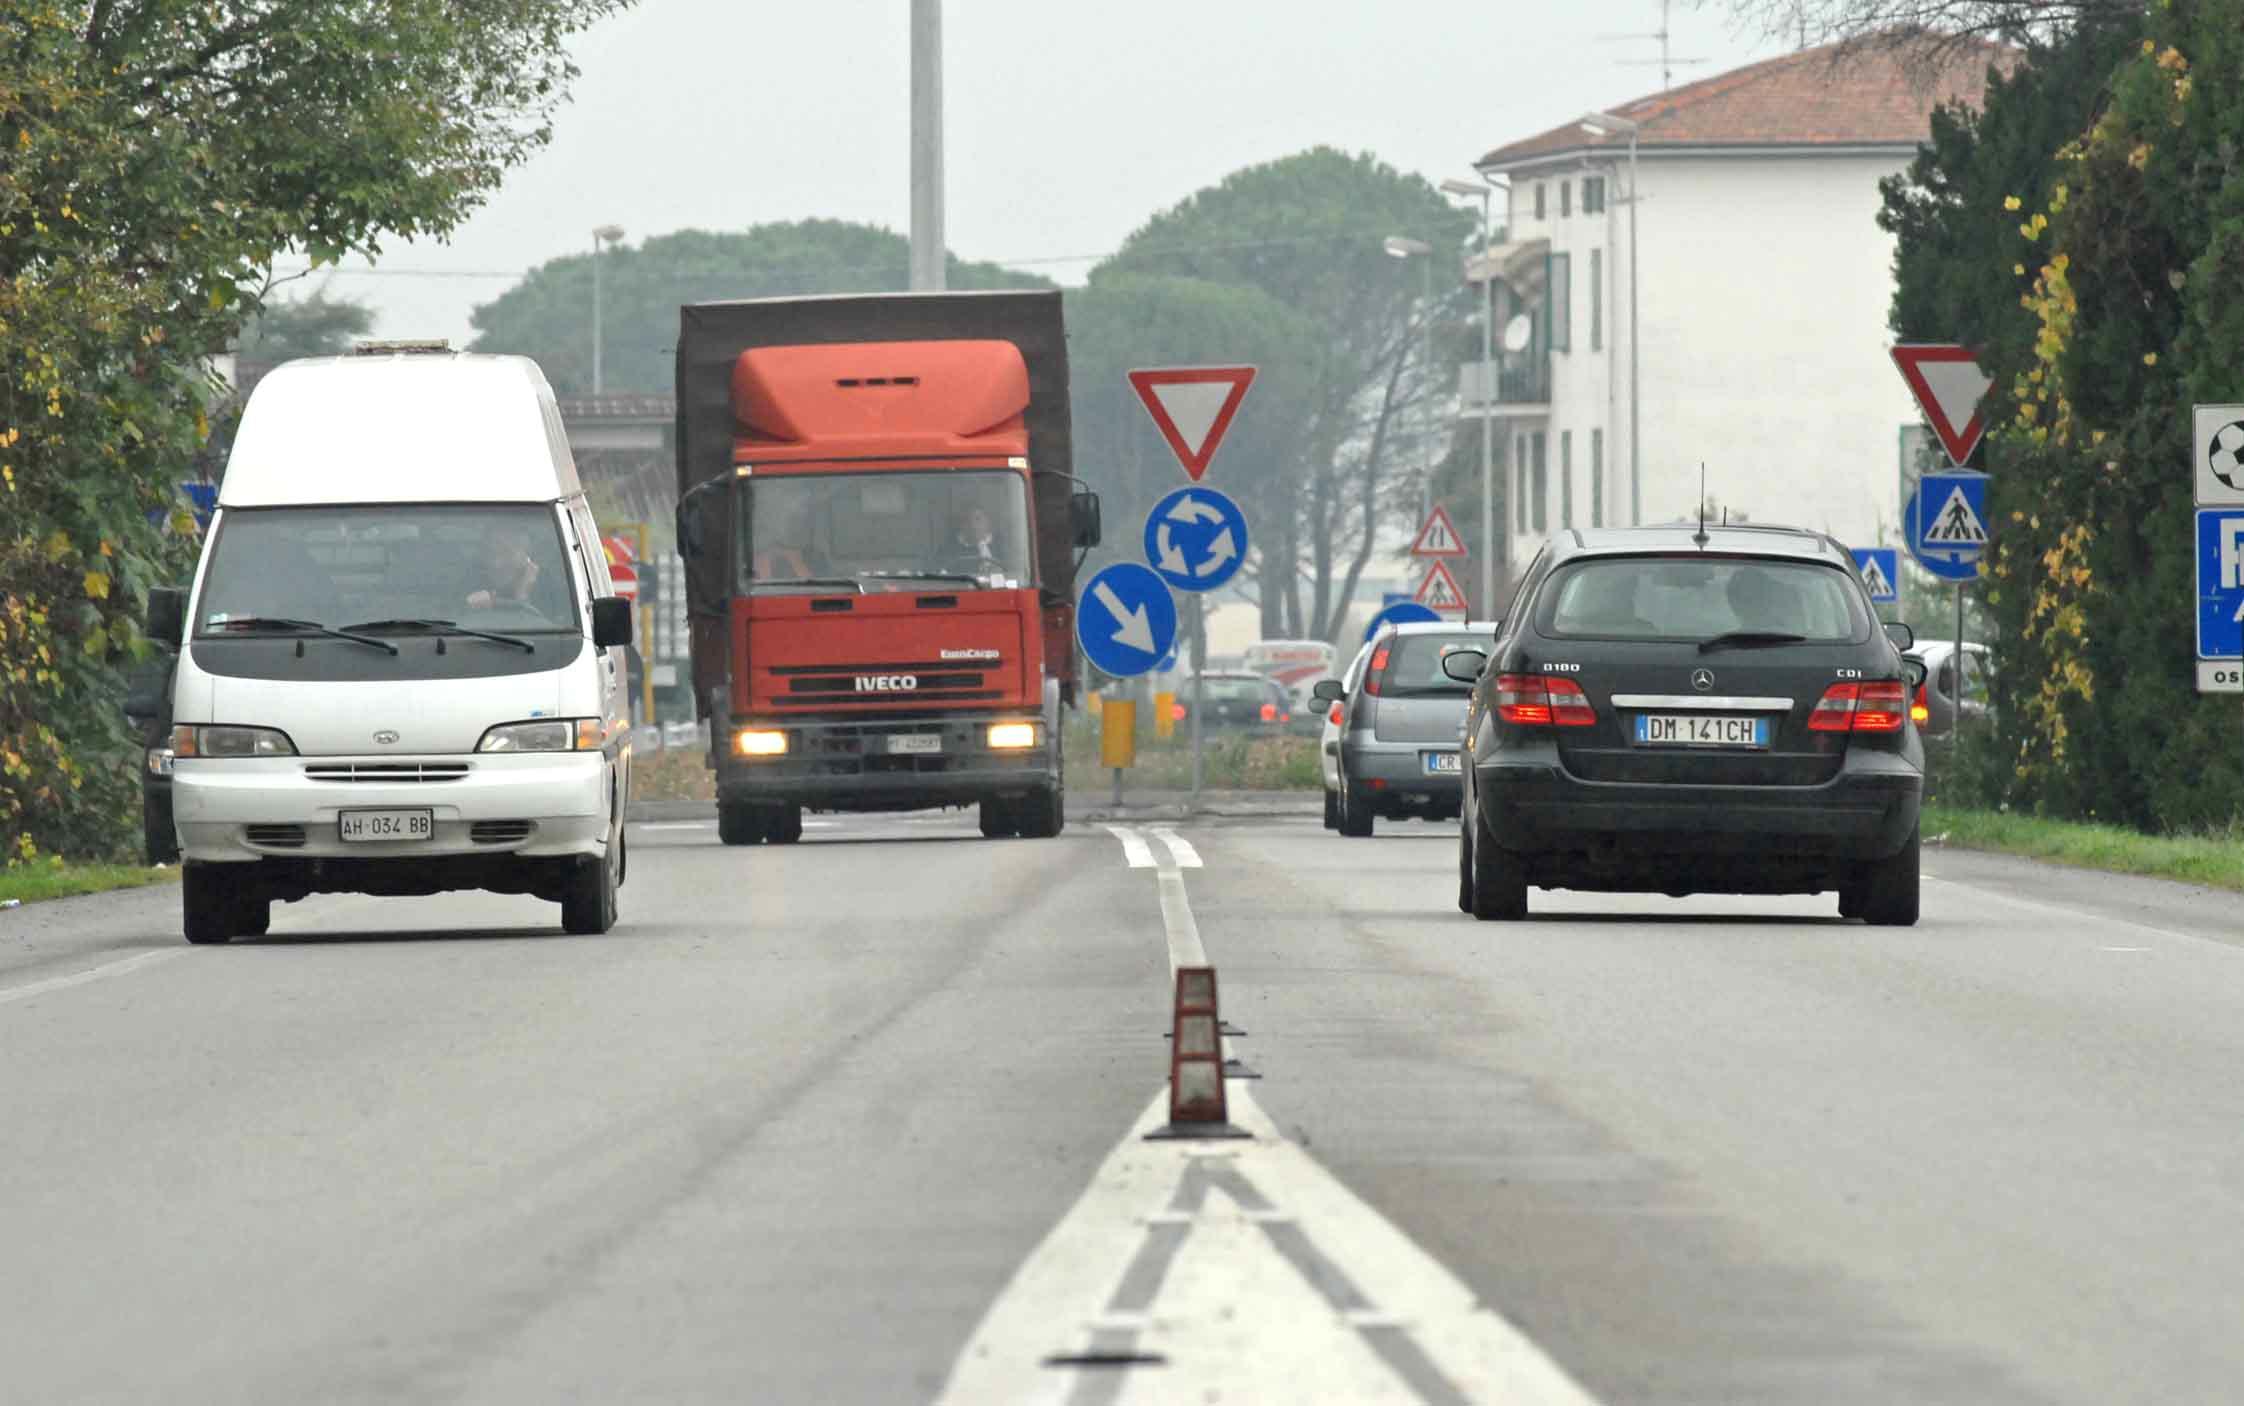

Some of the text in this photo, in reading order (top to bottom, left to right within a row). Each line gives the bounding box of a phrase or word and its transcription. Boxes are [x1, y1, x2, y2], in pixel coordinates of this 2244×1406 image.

[1837, 669, 1862, 678] CDI
[855, 675, 918, 691] IVECO
[1650, 718, 1753, 741] DM 141CH
[344, 816, 429, 834] AH 034 BB
